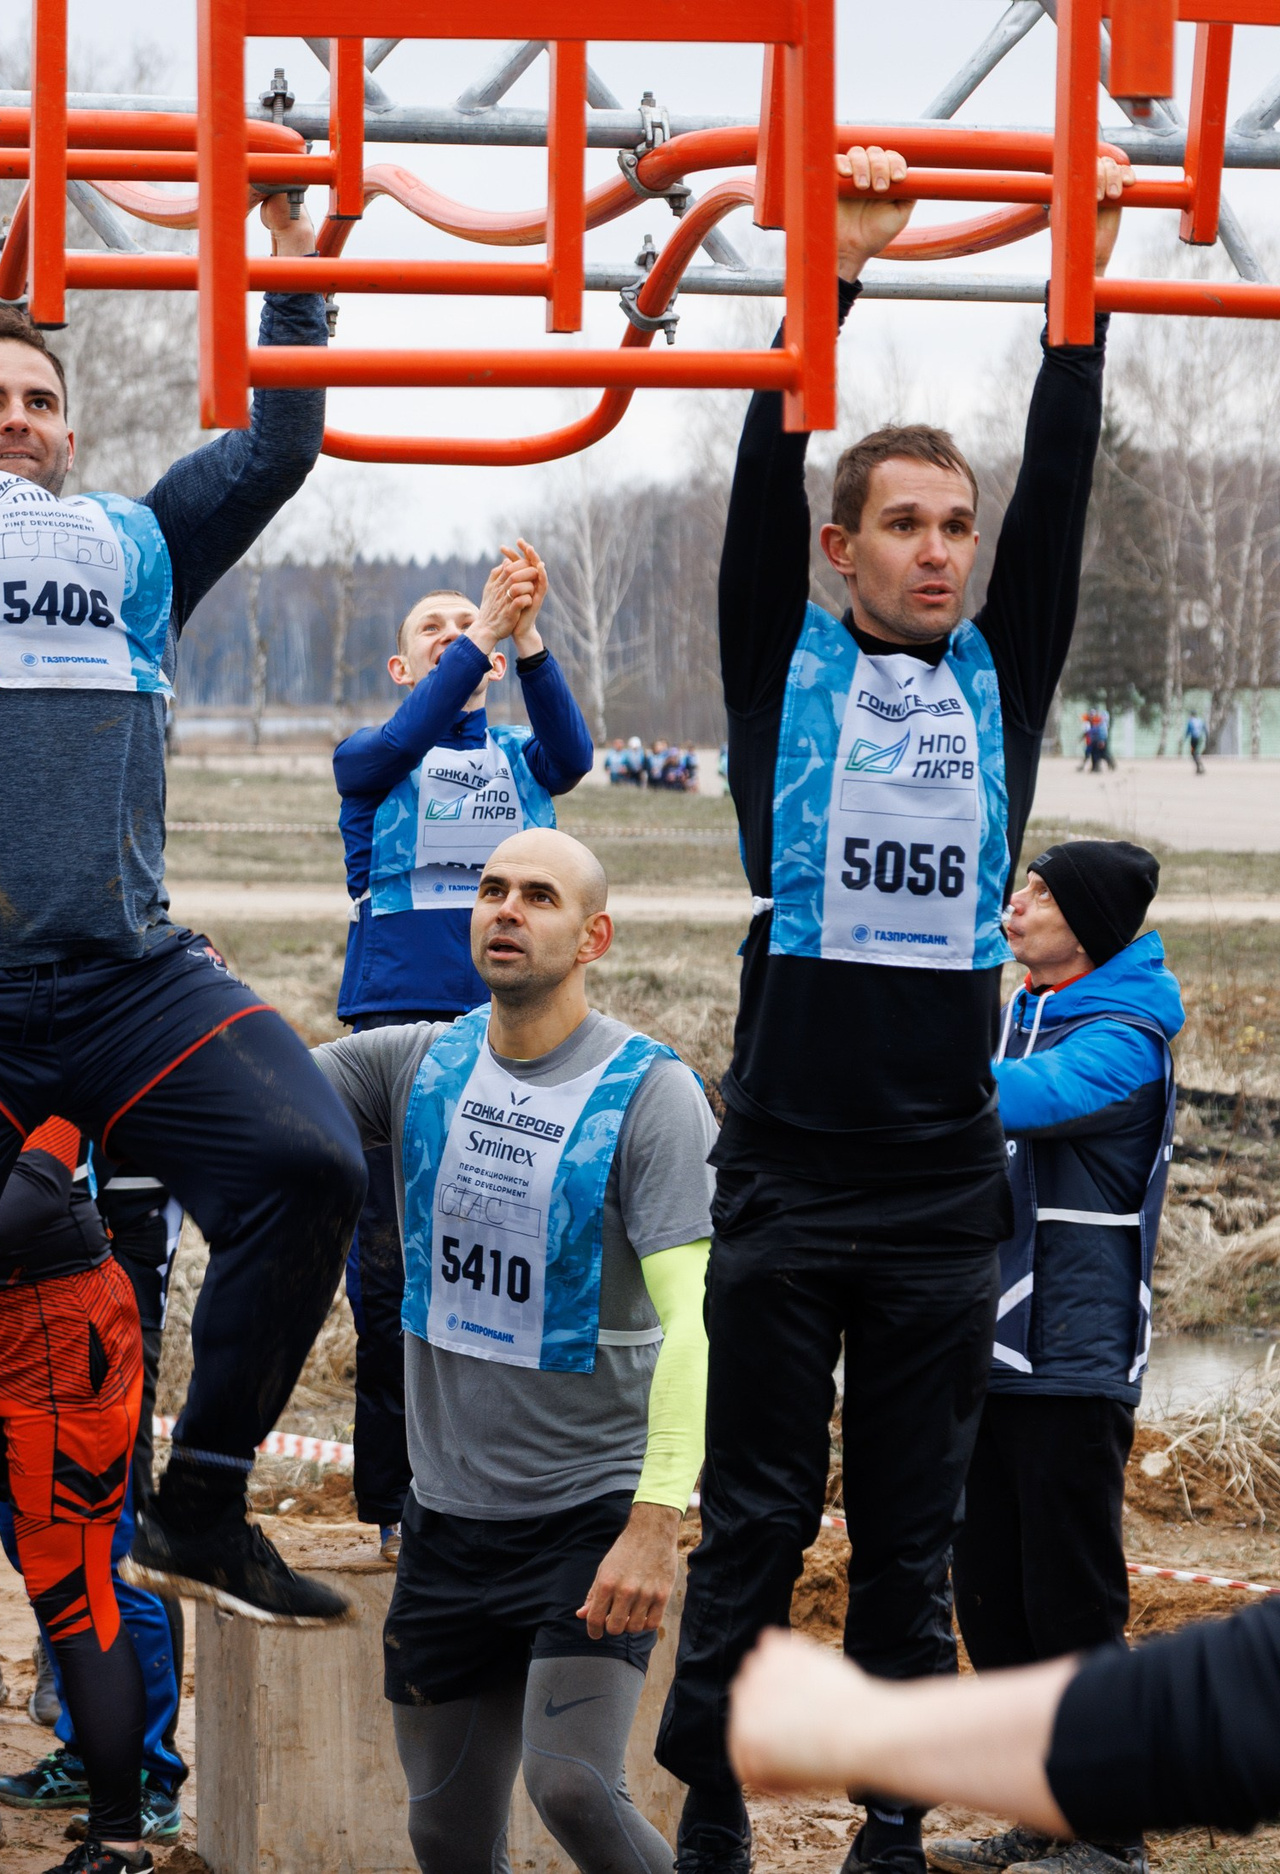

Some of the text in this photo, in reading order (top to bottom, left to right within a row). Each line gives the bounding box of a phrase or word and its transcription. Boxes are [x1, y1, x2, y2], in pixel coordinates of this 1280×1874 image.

[2, 510, 93, 524] ПЕРФЕКЦИОНИСТЫ
[4, 519, 95, 532] FINE DEVELOPMENT
[2, 580, 115, 628] 5406
[41, 655, 109, 666] ГАЗПРОМБАНК
[905, 694, 961, 714] ГЕОЕВ
[918, 734, 967, 755] НПО
[427, 768, 469, 784] ГОНКА
[911, 760, 975, 780] ПКРВ
[475, 790, 510, 803] НПО
[472, 805, 517, 820] ПКРВ
[841, 837, 966, 898] 5056
[874, 929, 948, 946] ГАЗПРОМБАНК
[463, 1100, 566, 1138] ГОНКА ГЕРОЕВ
[465, 1130, 537, 1167] Sminex
[459, 1162, 530, 1187] ПЕРФЕКЦИОНИСТЫ
[456, 1174, 527, 1199] FINE DEVELOPMENT
[441, 1235, 531, 1303] 5410
[461, 1319, 515, 1344] ГАЗПРОМБАНК
